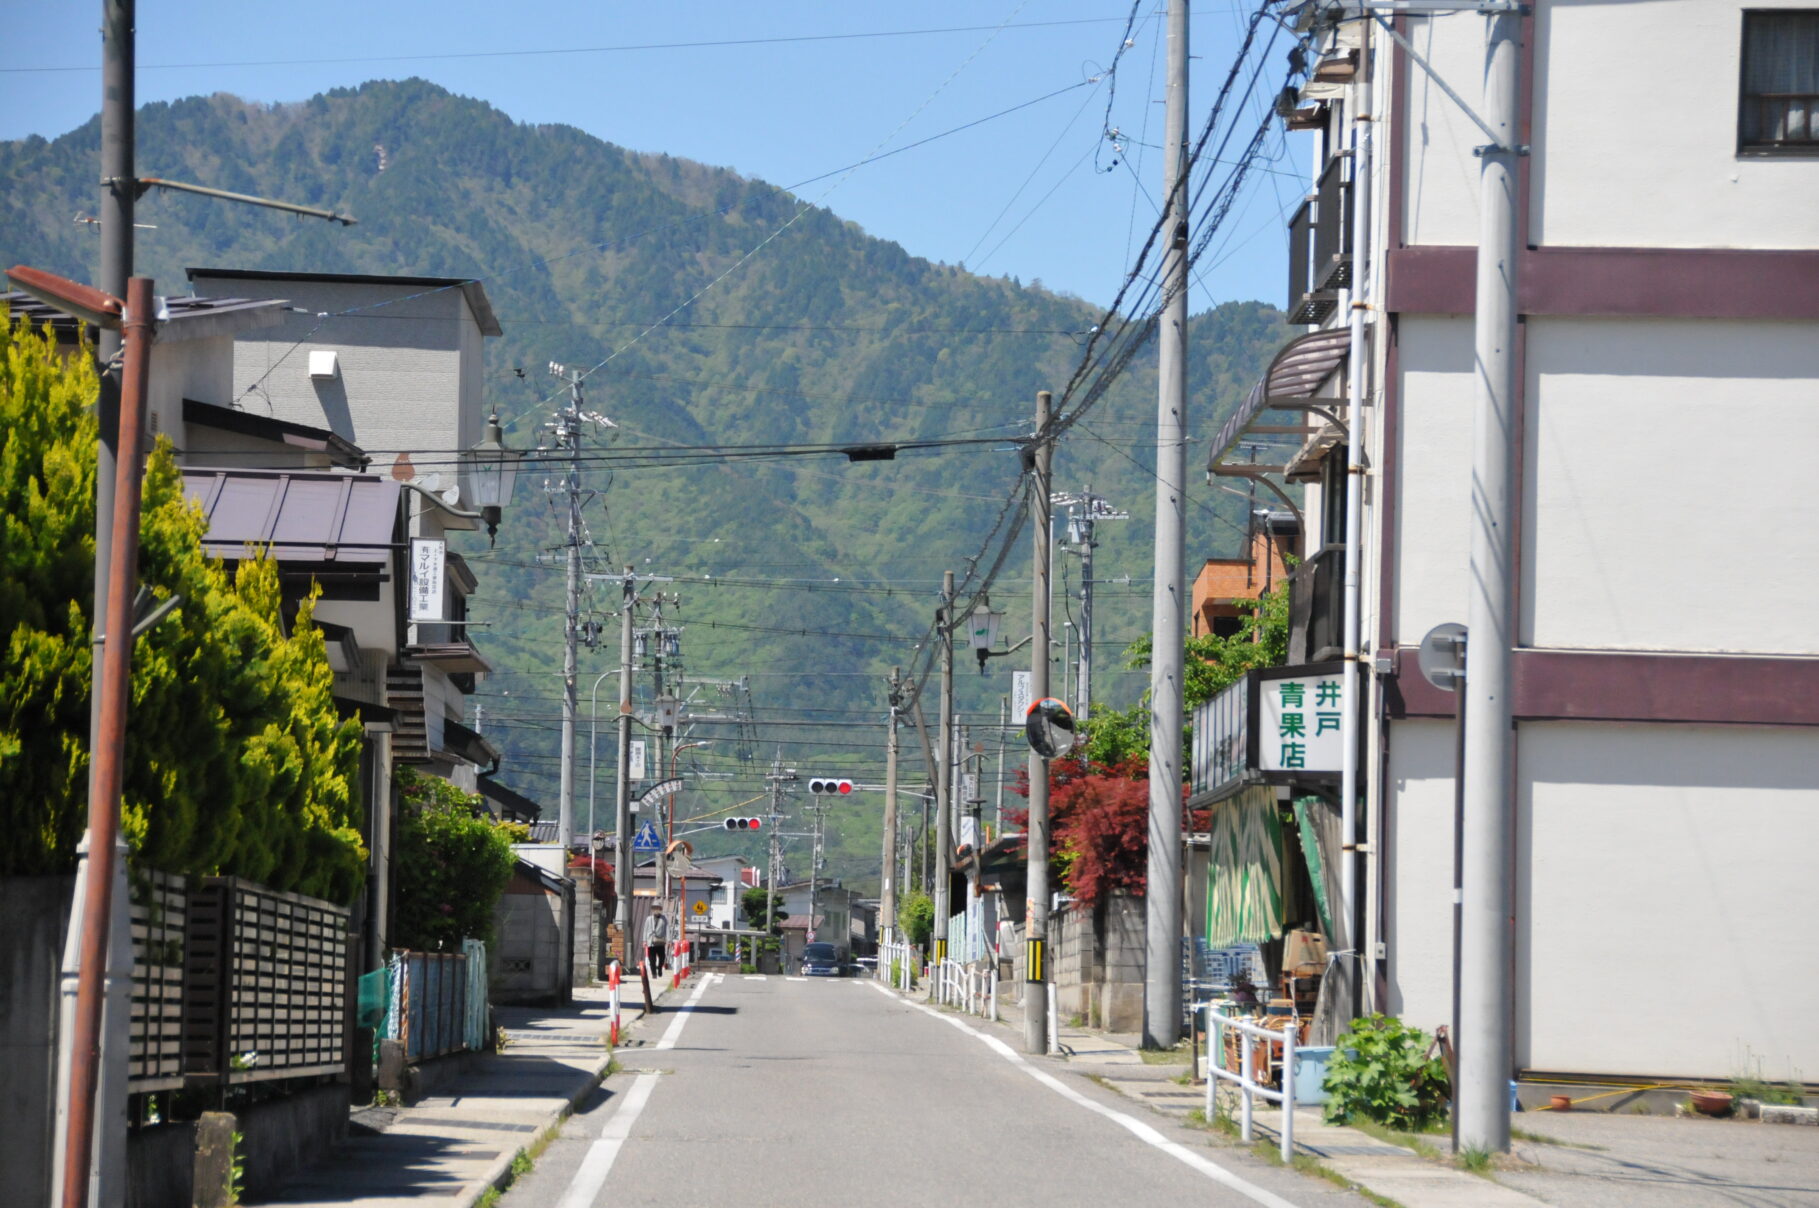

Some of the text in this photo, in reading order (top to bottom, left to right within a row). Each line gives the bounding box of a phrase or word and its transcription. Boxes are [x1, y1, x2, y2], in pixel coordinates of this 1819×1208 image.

[1279, 681, 1306, 768] 青果店
[1315, 681, 1342, 737] 井戸
